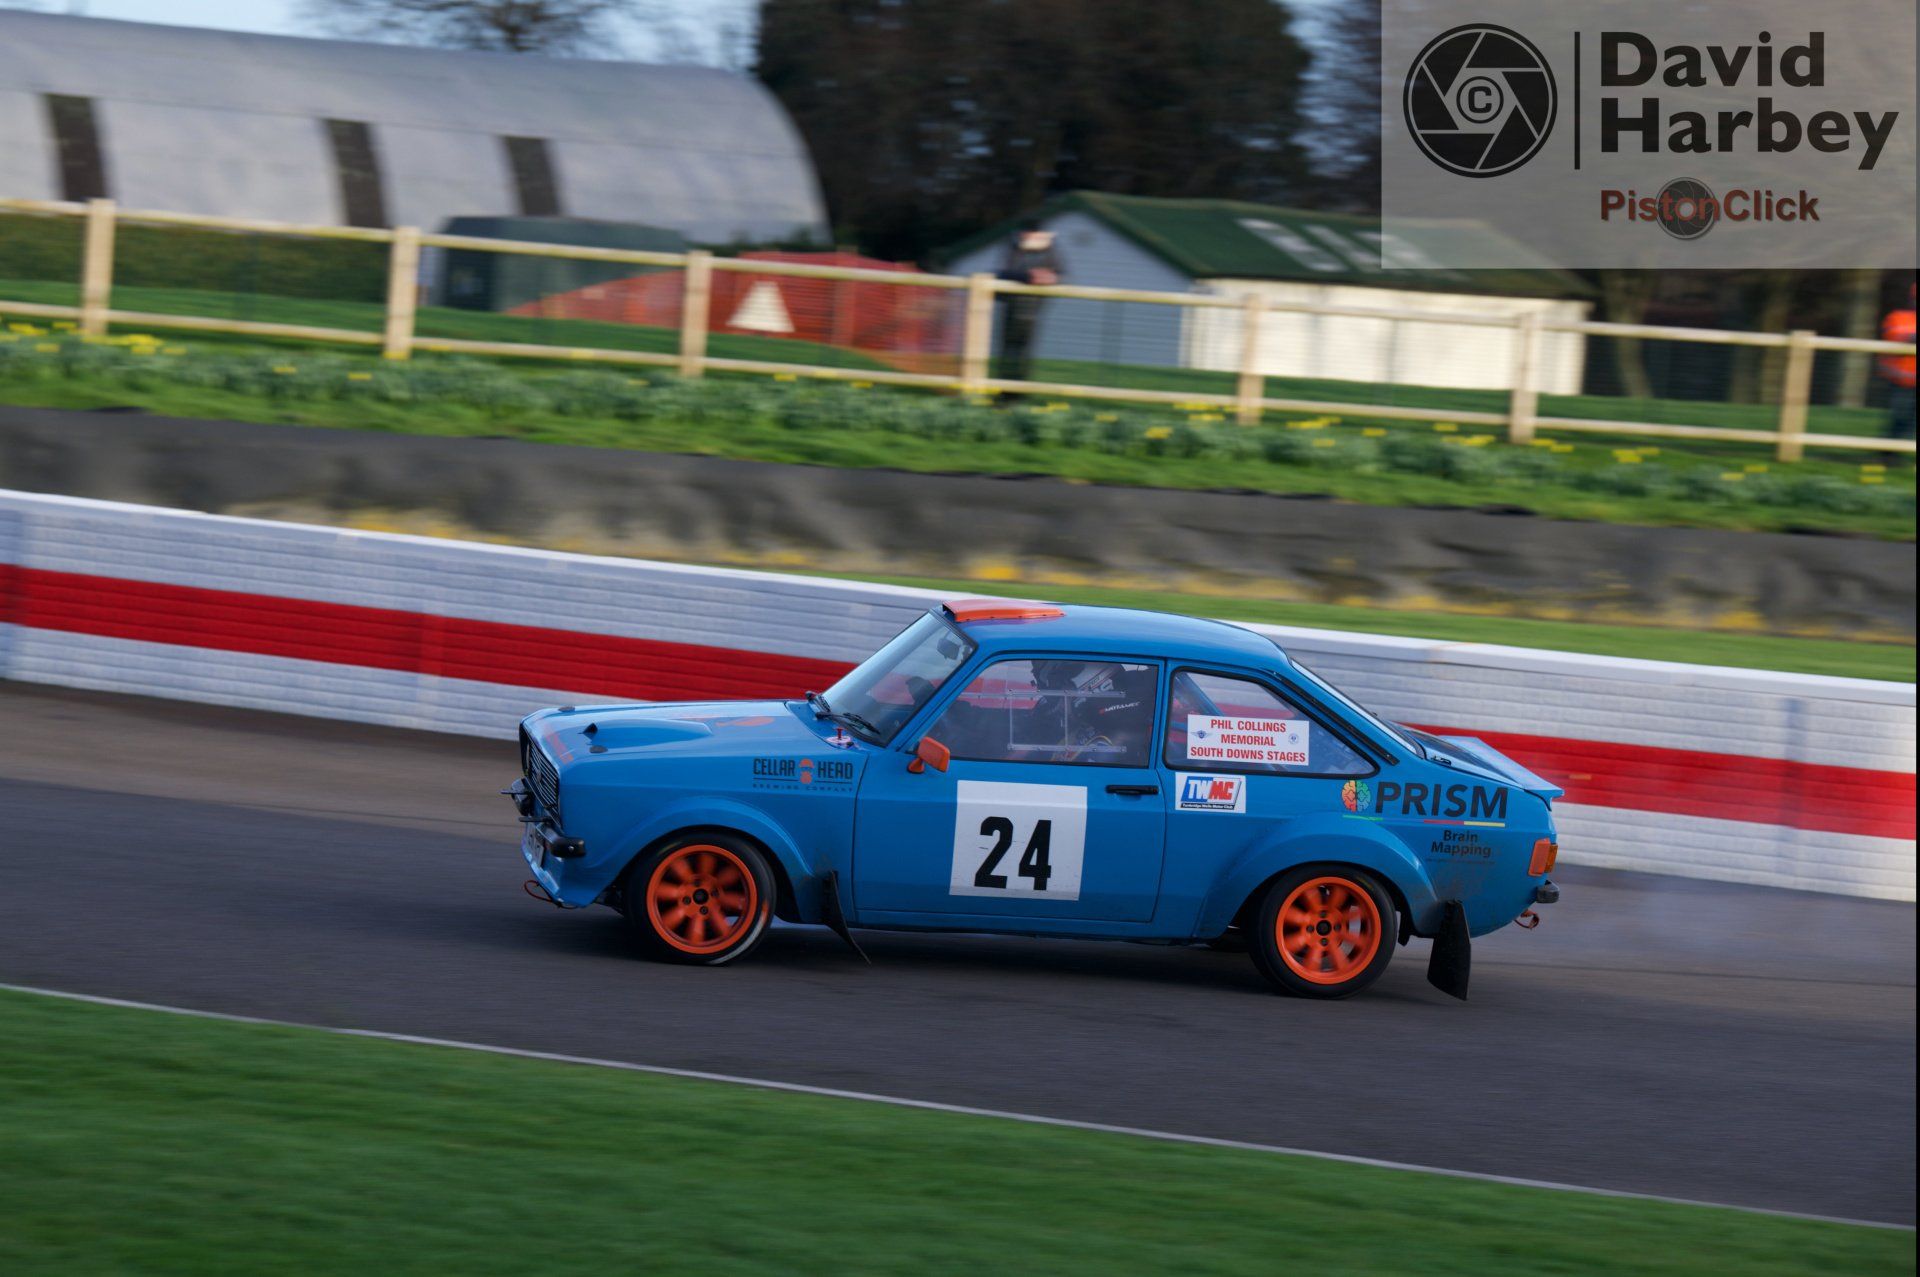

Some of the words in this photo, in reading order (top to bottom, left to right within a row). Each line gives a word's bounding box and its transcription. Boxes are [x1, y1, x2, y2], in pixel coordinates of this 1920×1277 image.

[1210, 719, 1233, 730] PHIL
[1237, 721, 1286, 732] COLLINGS
[1221, 734, 1276, 746] MEMORIAL
[1190, 746, 1223, 758] SOUTH
[1226, 748, 1264, 760] DOWNS
[1267, 750, 1306, 762] STAGES
[753, 758, 796, 776] CELLAR
[817, 761, 853, 779] HEAD
[1188, 779, 1235, 802] TWMC
[1375, 781, 1508, 819] PRISM
[1443, 829, 1478, 842] Brain
[973, 816, 1052, 890] 24
[1430, 841, 1492, 858] Mapping
